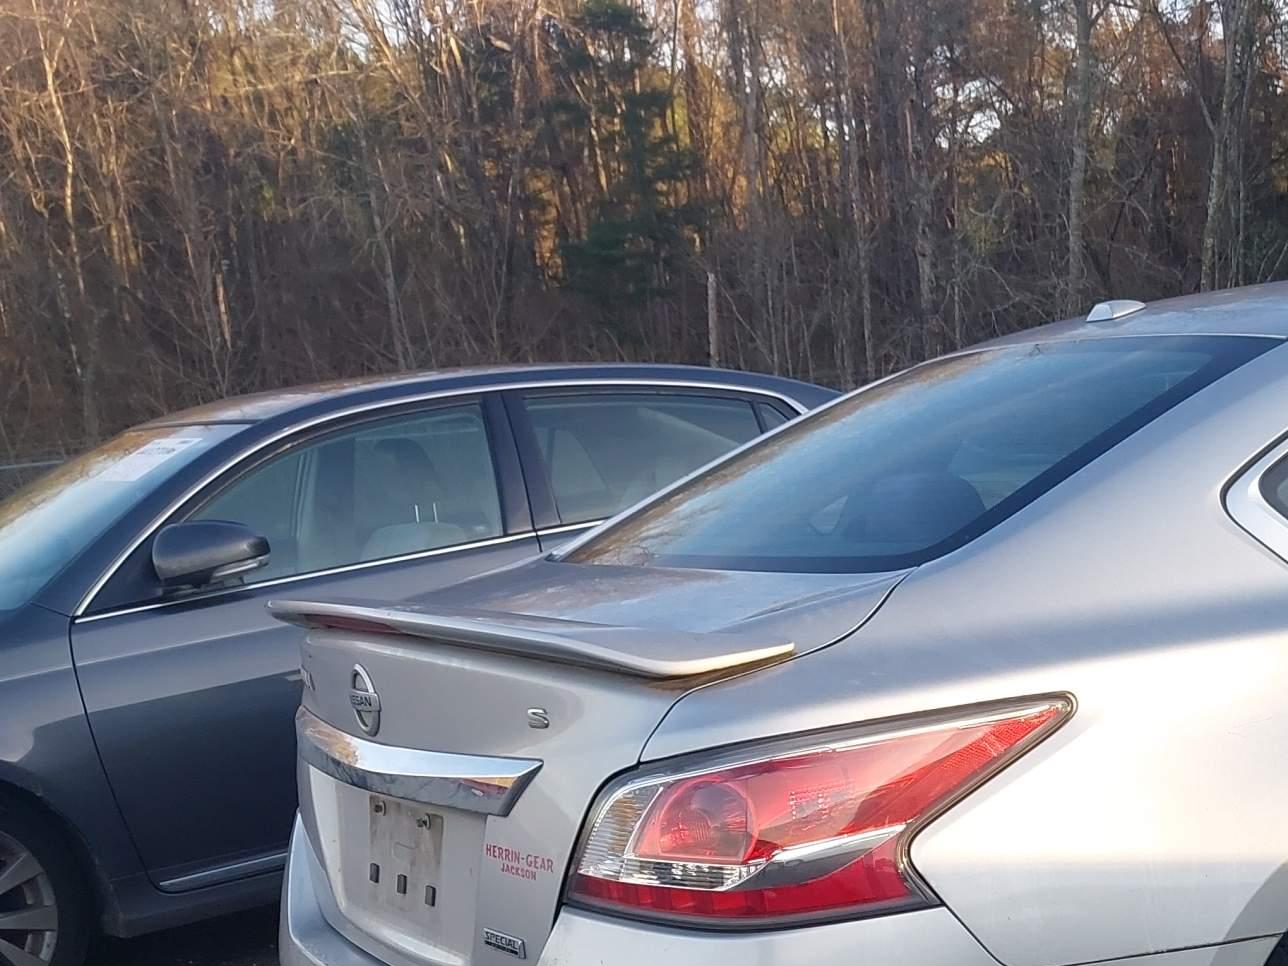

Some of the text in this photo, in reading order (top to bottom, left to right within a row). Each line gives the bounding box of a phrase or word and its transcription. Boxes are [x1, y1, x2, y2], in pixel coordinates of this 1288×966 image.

[528, 708, 549, 729] S
[486, 843, 554, 873] HERRIN-GEAR
[501, 863, 537, 880] JACKSON
[485, 931, 519, 950] SPECIAL
